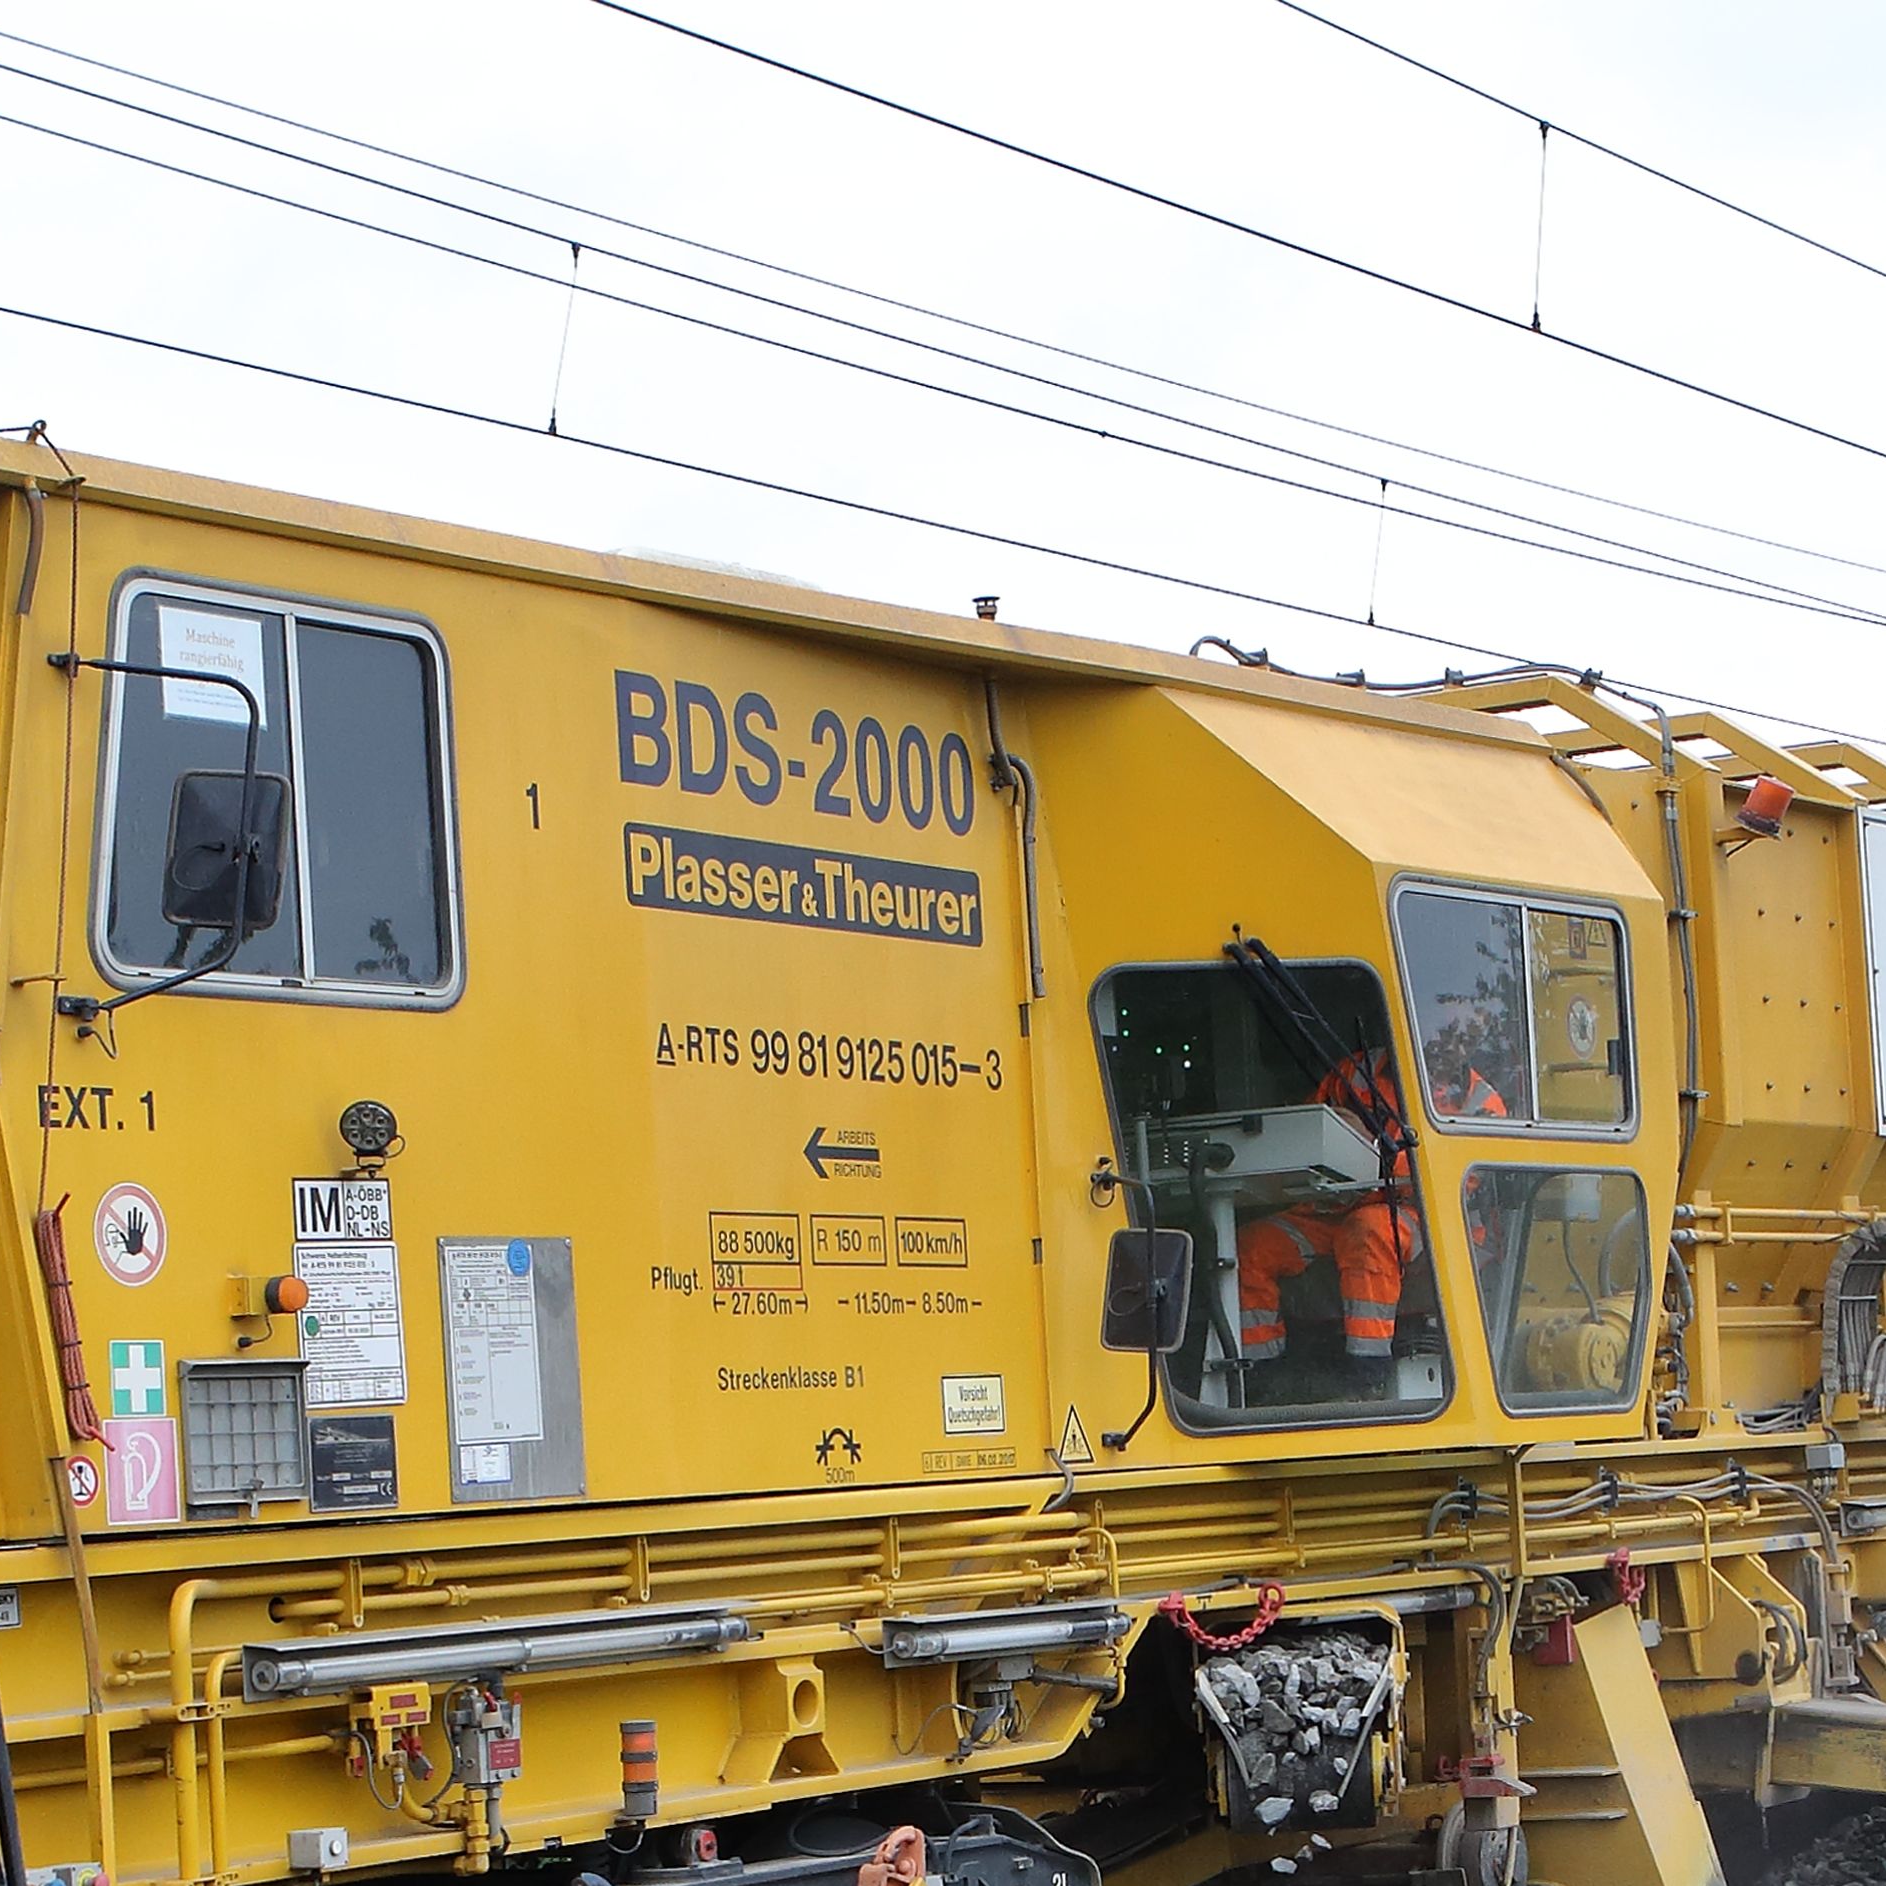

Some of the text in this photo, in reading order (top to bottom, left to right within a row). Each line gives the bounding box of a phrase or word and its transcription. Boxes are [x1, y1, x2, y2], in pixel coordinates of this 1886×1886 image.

[185, 628, 236, 648] Maschine
[614, 669, 975, 836] BDS-2000
[526, 783, 540, 829] 1
[657, 1023, 739, 1066] A-RTS
[750, 1029, 790, 1075] 99
[798, 1031, 828, 1078] 81
[836, 1036, 905, 1084] 9125
[38, 1085, 155, 1131] EXT. 1
[837, 1131, 876, 1145] ARBEITS
[834, 1163, 882, 1179] RICHTUNG
[298, 1187, 341, 1232] IM
[346, 1205, 379, 1220] D-DB
[718, 1231, 794, 1260] 88 500kg
[816, 1229, 882, 1252] R 150 m
[651, 1266, 703, 1296] Pflugt.
[716, 1265, 735, 1287] 39
[717, 1366, 838, 1391] Streckenklasse
[958, 1384, 989, 1402] Vorsicht
[825, 1467, 856, 1484] 500m
